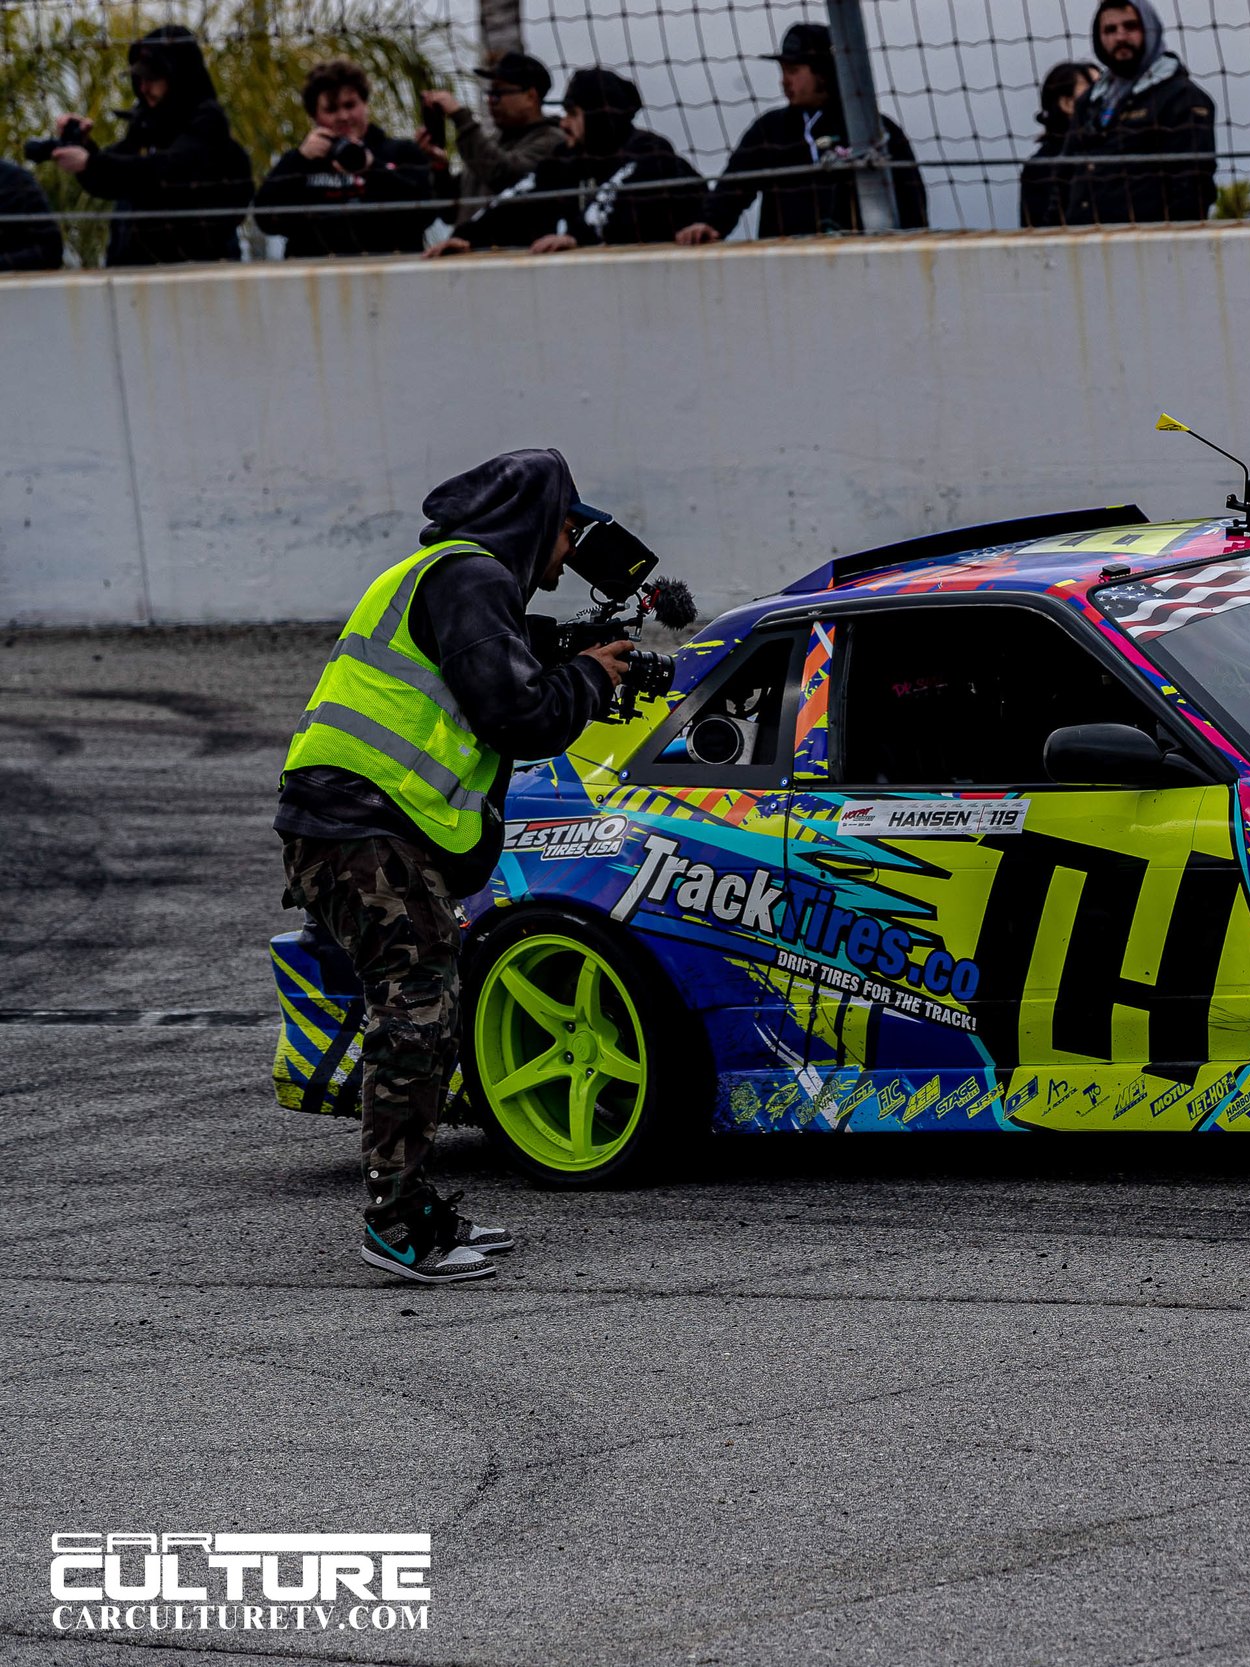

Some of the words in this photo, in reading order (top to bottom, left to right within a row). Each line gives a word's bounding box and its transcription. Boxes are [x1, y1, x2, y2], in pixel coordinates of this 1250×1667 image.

[503, 816, 627, 848] ZESTINO
[888, 810, 972, 827] HANSEN
[989, 810, 1020, 826] 119
[544, 842, 584, 857] TIRES
[587, 840, 621, 854] USA
[777, 950, 818, 978] DRIFT
[820, 965, 860, 993] TIRES
[862, 978, 892, 1003] FOR
[895, 989, 921, 1014] THE
[924, 1000, 978, 1031] TRACK!
[877, 1078, 902, 1109] FIC
[935, 1076, 976, 1116] STAGE
[1189, 1073, 1231, 1120] JET-HOT
